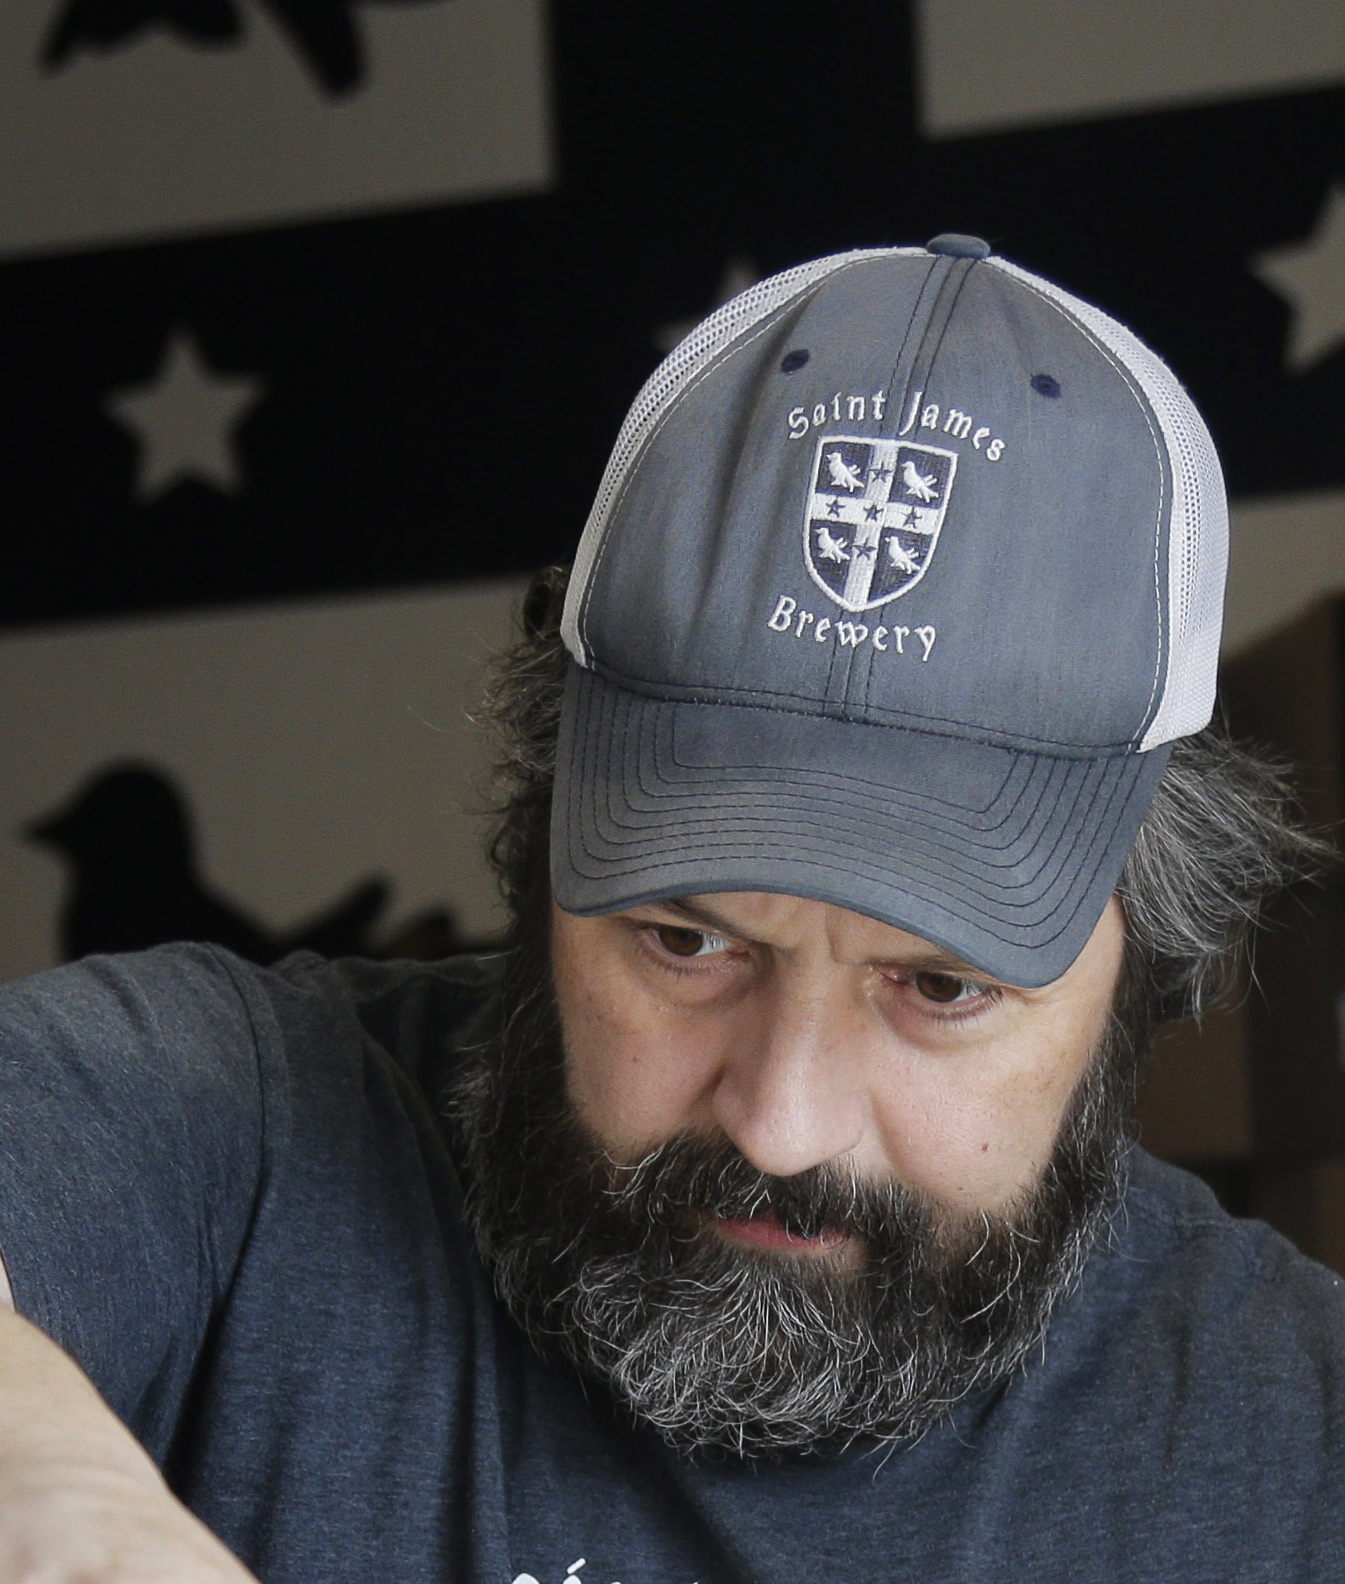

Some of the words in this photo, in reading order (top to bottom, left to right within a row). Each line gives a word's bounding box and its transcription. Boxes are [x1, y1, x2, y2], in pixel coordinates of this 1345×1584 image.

[788, 390, 887, 440] Saint
[899, 391, 1006, 462] James
[767, 594, 937, 662] Brewery
